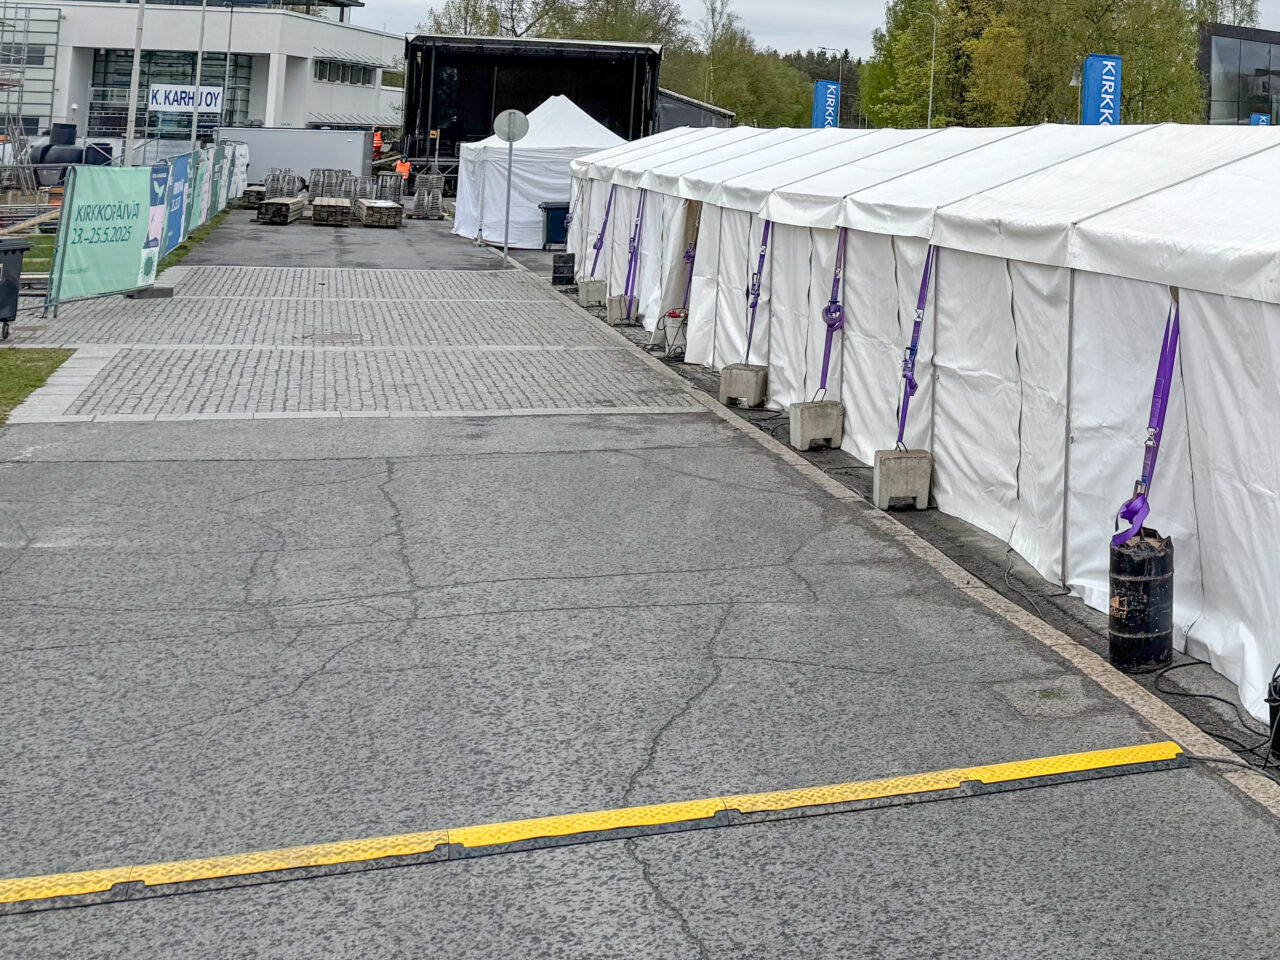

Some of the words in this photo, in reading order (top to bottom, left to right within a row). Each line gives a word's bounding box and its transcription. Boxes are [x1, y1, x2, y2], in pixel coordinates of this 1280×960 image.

[151, 89, 162, 105] K.
[204, 91, 220, 107] OY
[75, 200, 140, 222] KIRKKOPÄIVÄT
